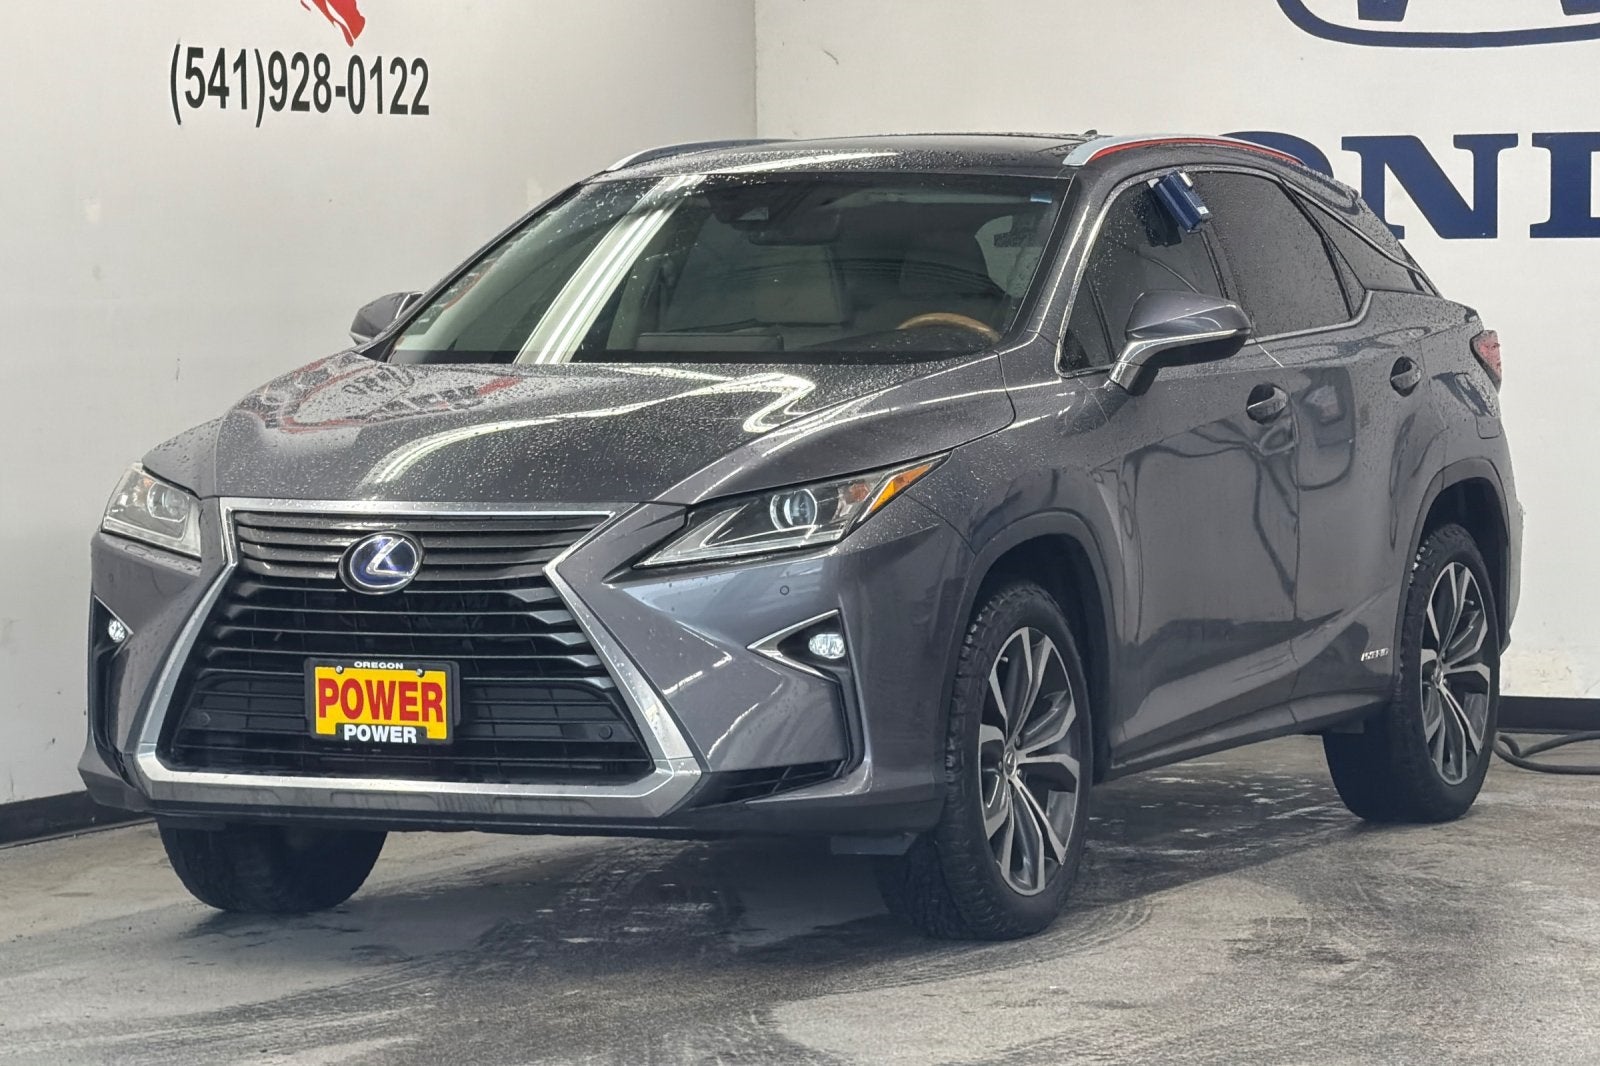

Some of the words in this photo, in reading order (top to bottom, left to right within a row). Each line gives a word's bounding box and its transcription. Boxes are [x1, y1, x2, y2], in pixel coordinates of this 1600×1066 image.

[170, 43, 430, 128] (541)928-0122
[353, 660, 404, 670] OREGON
[318, 677, 444, 723] POWER
[343, 724, 417, 744] POWER
